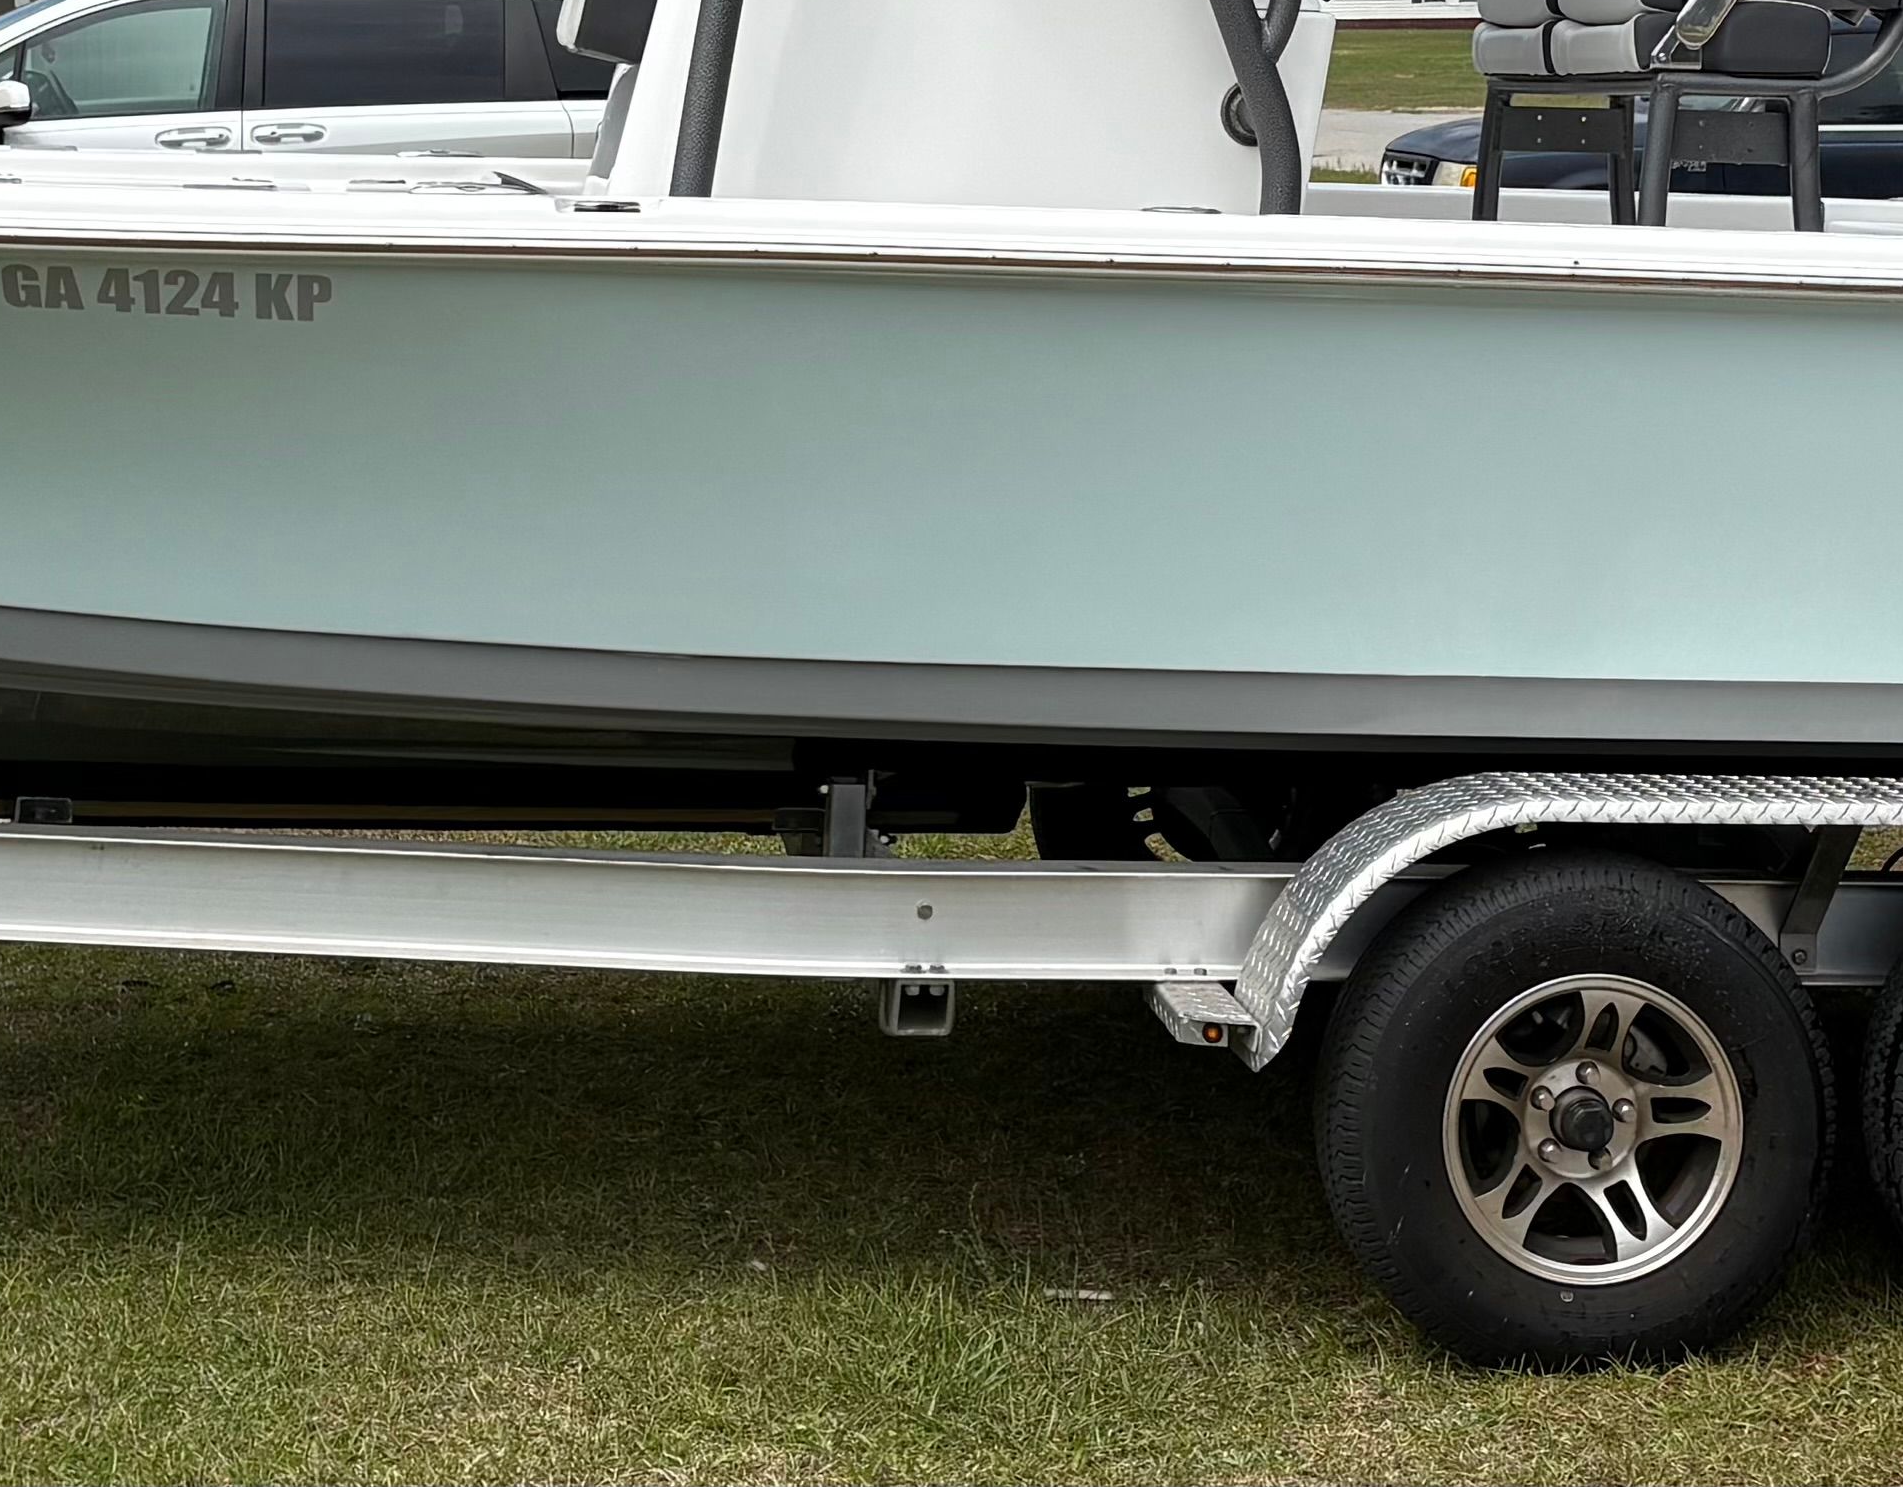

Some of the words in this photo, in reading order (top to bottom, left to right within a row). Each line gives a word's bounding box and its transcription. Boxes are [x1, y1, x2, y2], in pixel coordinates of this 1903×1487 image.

[1, 264, 85, 310] GA
[97, 268, 239, 318] 4124
[255, 273, 332, 321] KP
